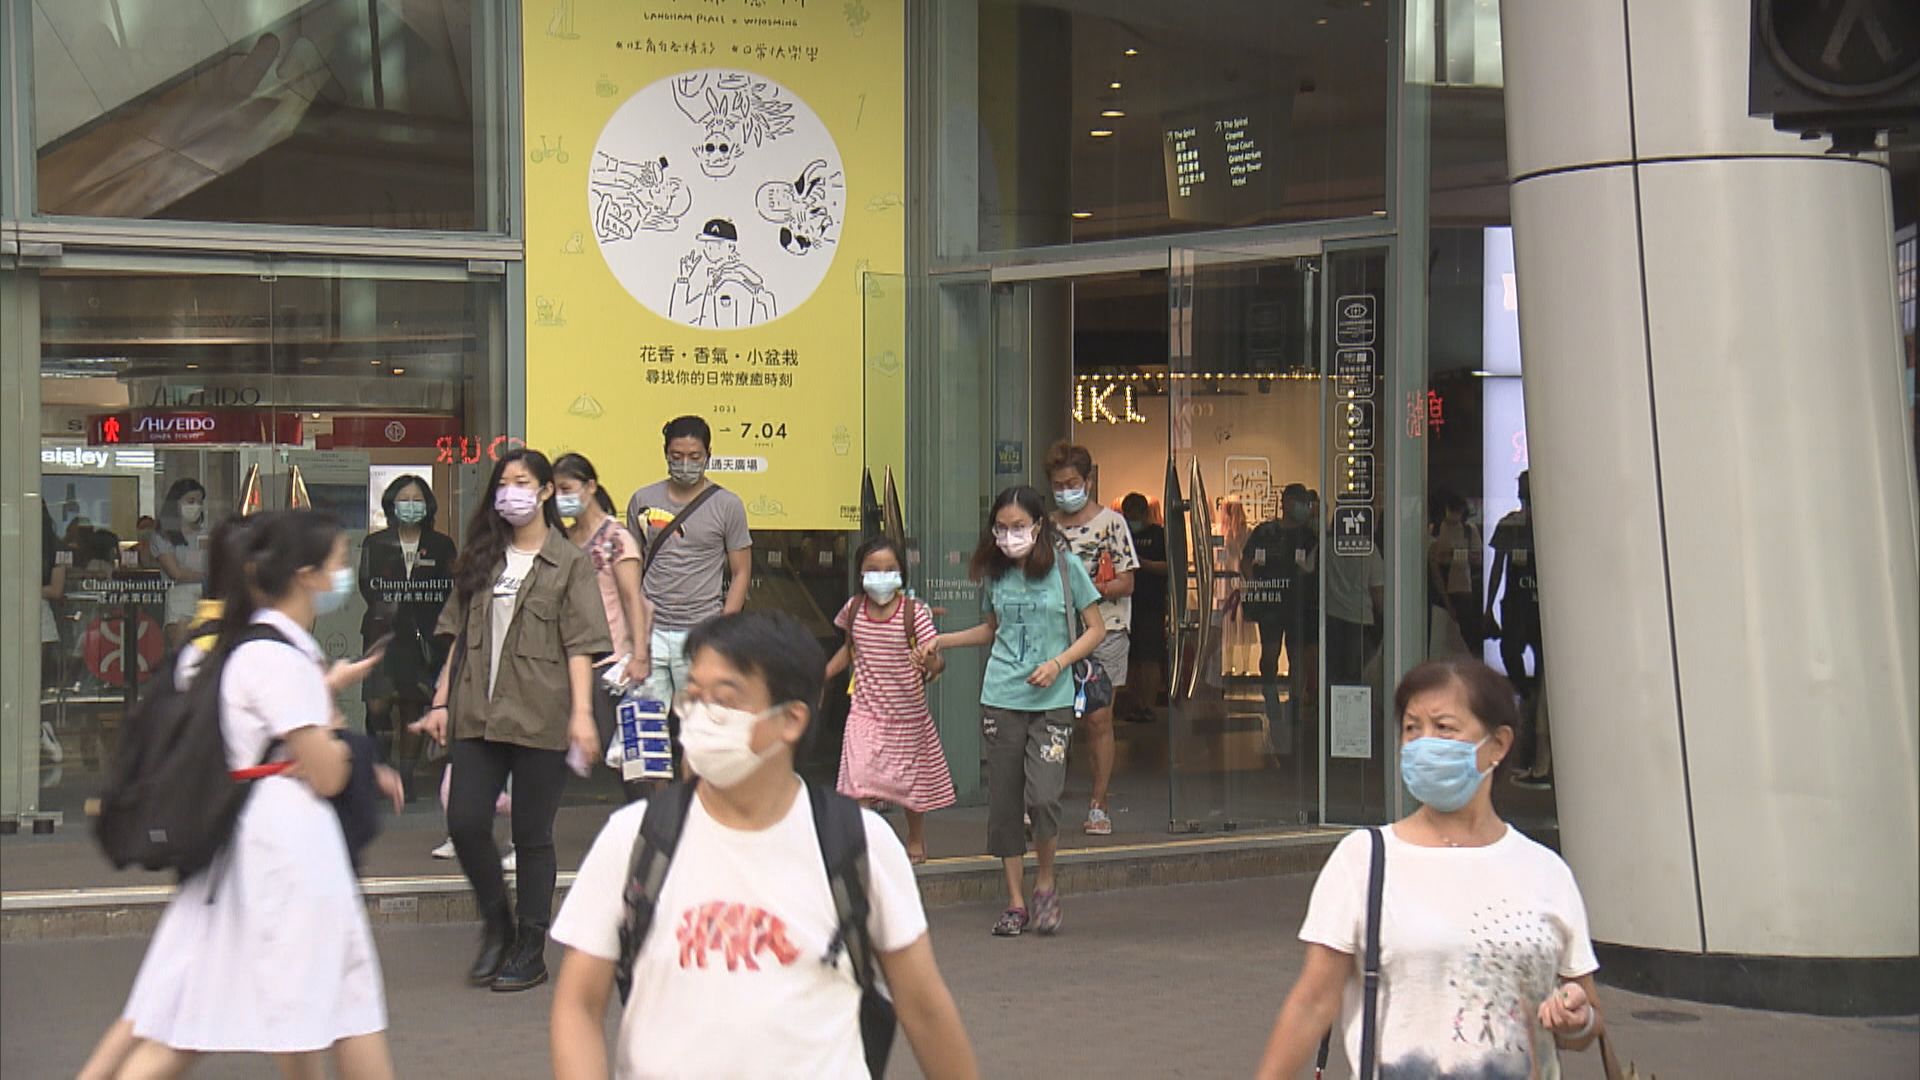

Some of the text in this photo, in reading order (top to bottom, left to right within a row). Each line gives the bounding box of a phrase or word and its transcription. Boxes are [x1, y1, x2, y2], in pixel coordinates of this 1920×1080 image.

[133, 417, 215, 432] SHISEIDO
[741, 423, 787, 439] 7.04
[41, 448, 109, 468] sisley
